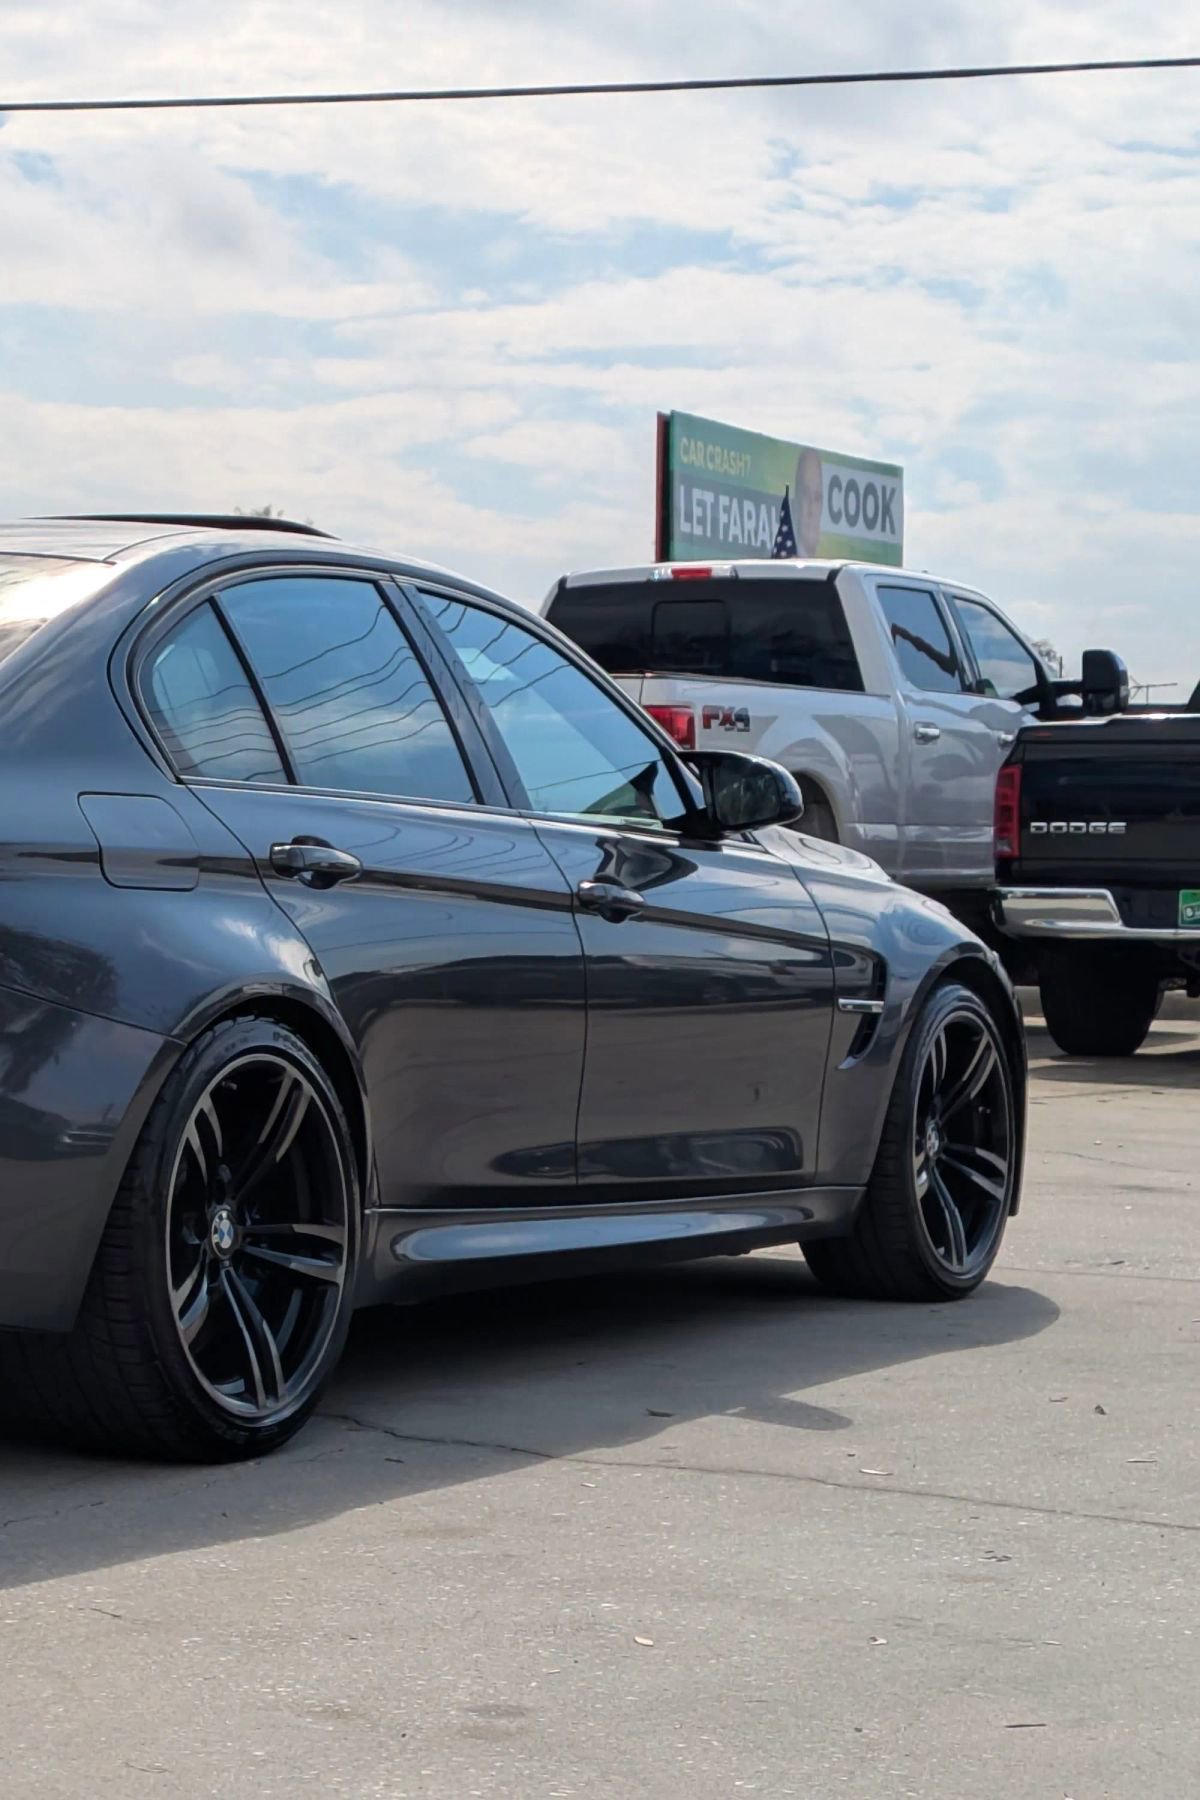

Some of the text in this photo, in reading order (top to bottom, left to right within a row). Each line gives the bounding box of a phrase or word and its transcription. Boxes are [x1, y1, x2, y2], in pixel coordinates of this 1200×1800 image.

[681, 437, 704, 467] CAR
[680, 485, 714, 538] LET
[828, 474, 896, 535] COOK
[1030, 822, 1127, 834] DODGE
